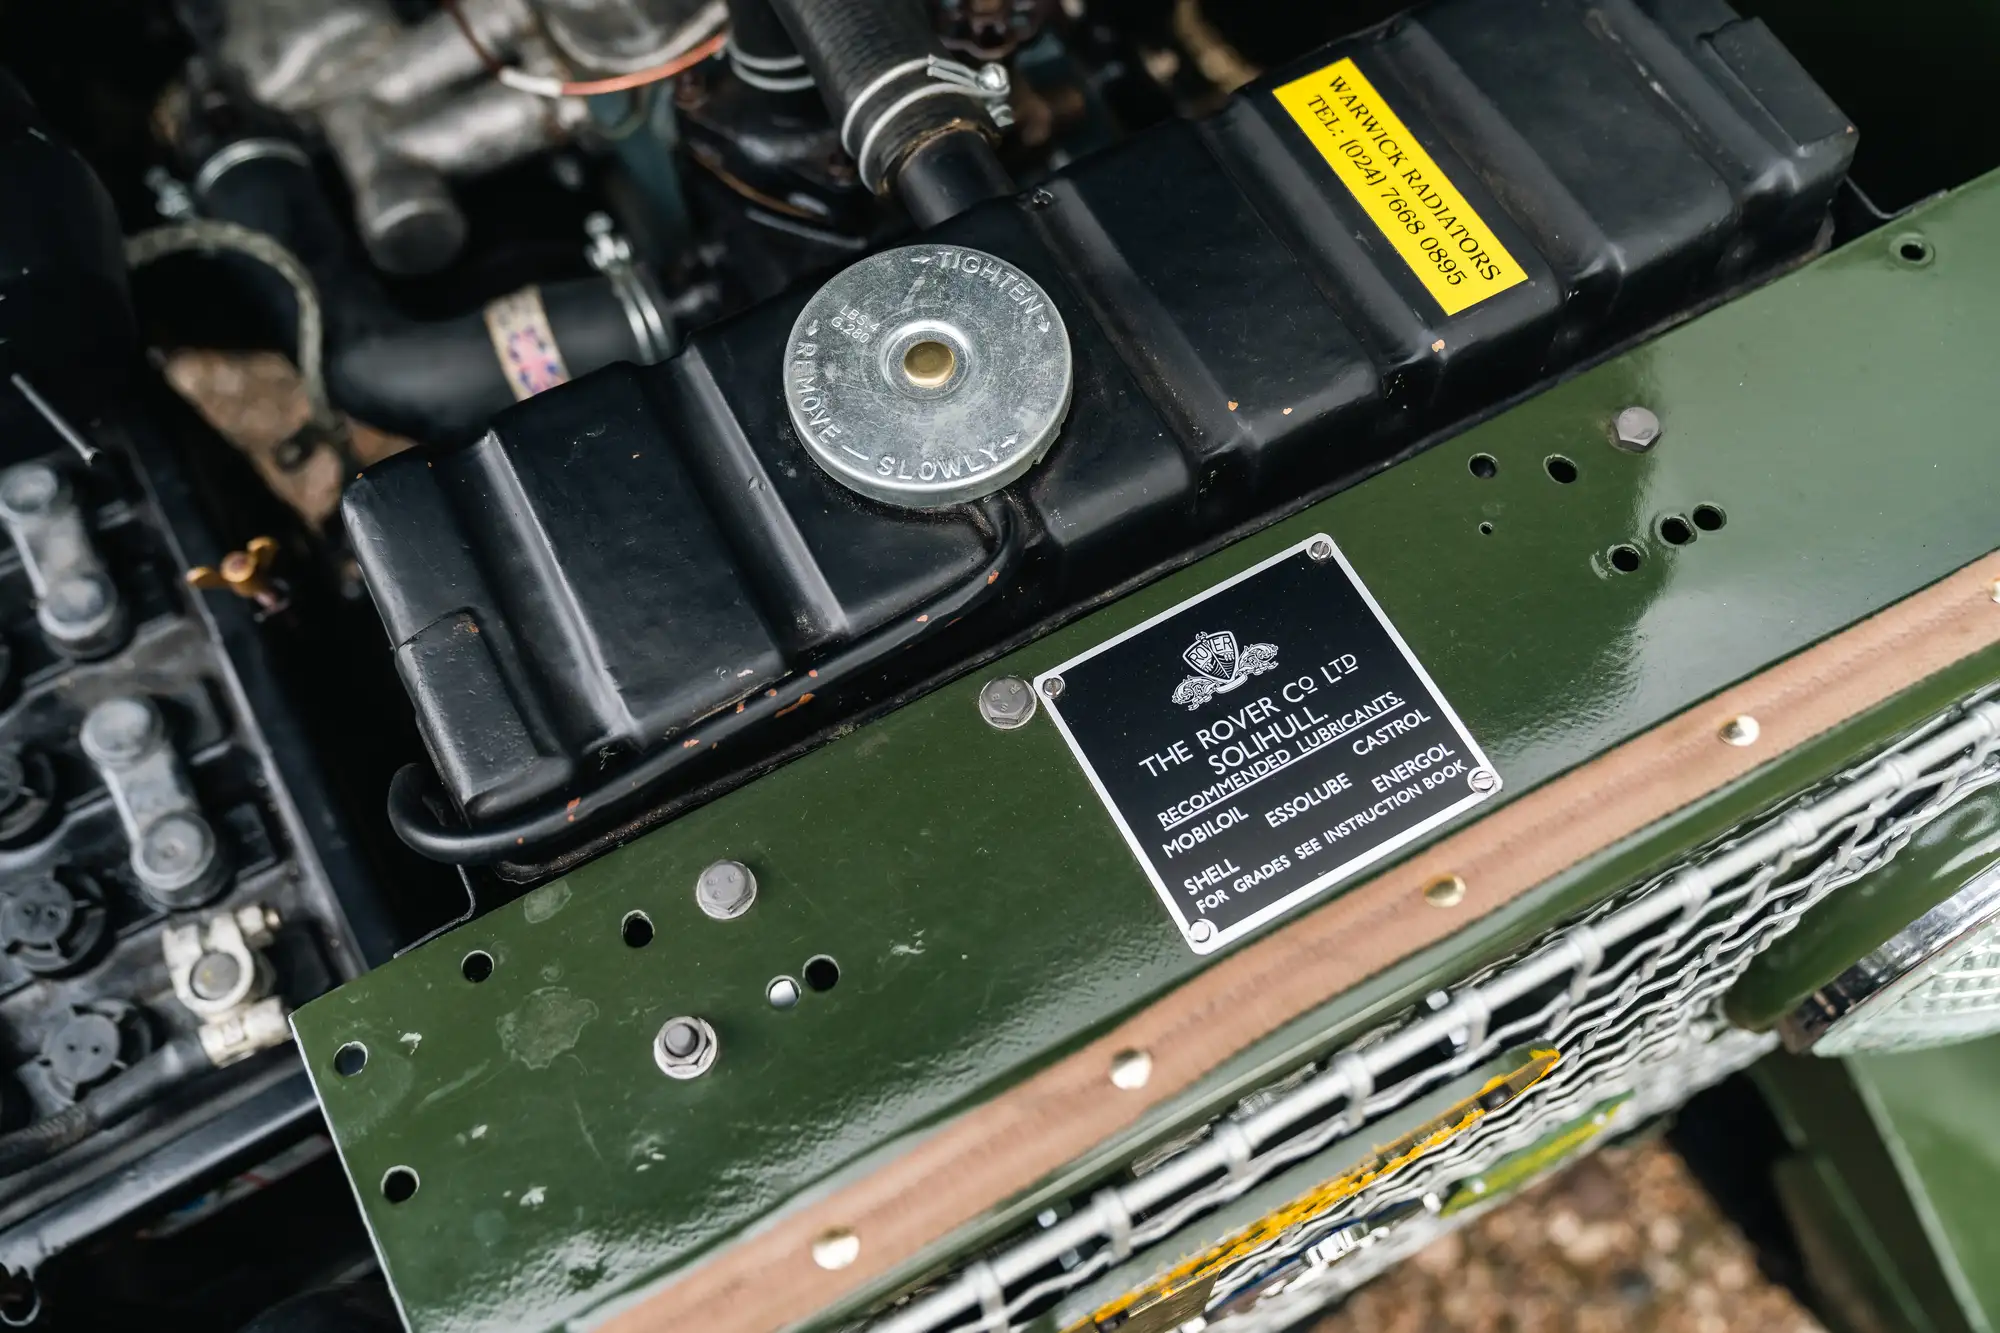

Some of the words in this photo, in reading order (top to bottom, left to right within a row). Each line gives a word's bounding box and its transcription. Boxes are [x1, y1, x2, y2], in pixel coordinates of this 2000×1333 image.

[1306, 94, 1344, 137] TEL:
[1338, 139, 1387, 186] (024)
[1381, 187, 1425, 235] 7668
[1420, 236, 1468, 286] 0895
[1329, 75, 1409, 168] WARWICK
[1401, 168, 1502, 281] RADIATORS
[936, 250, 1044, 315] TIGHTEN
[794, 341, 842, 444] REMOVE
[876, 447, 999, 481] SLOWLY
[1138, 740, 1194, 777] THE
[1195, 696, 1281, 750] ROVER
[1320, 653, 1359, 683] LTD
[1156, 748, 1291, 828] RECOMMENDED
[1295, 690, 1404, 755] LUBRICANTS.
[1161, 805, 1250, 859] MOBILOIL
[1352, 708, 1431, 756] CASTROL
[1207, 706, 1329, 775] SOLIHULL.
[1183, 858, 1241, 896] SHELL
[1371, 742, 1456, 794] ENERGOL
[1195, 889, 1231, 915] FOR
[1233, 854, 1292, 893] GRADES
[1294, 837, 1323, 861] SEE
[1323, 782, 1424, 845] INSTRUCTION
[1421, 759, 1469, 791] BOOK
[1264, 772, 1353, 829] ESSOLUBE
